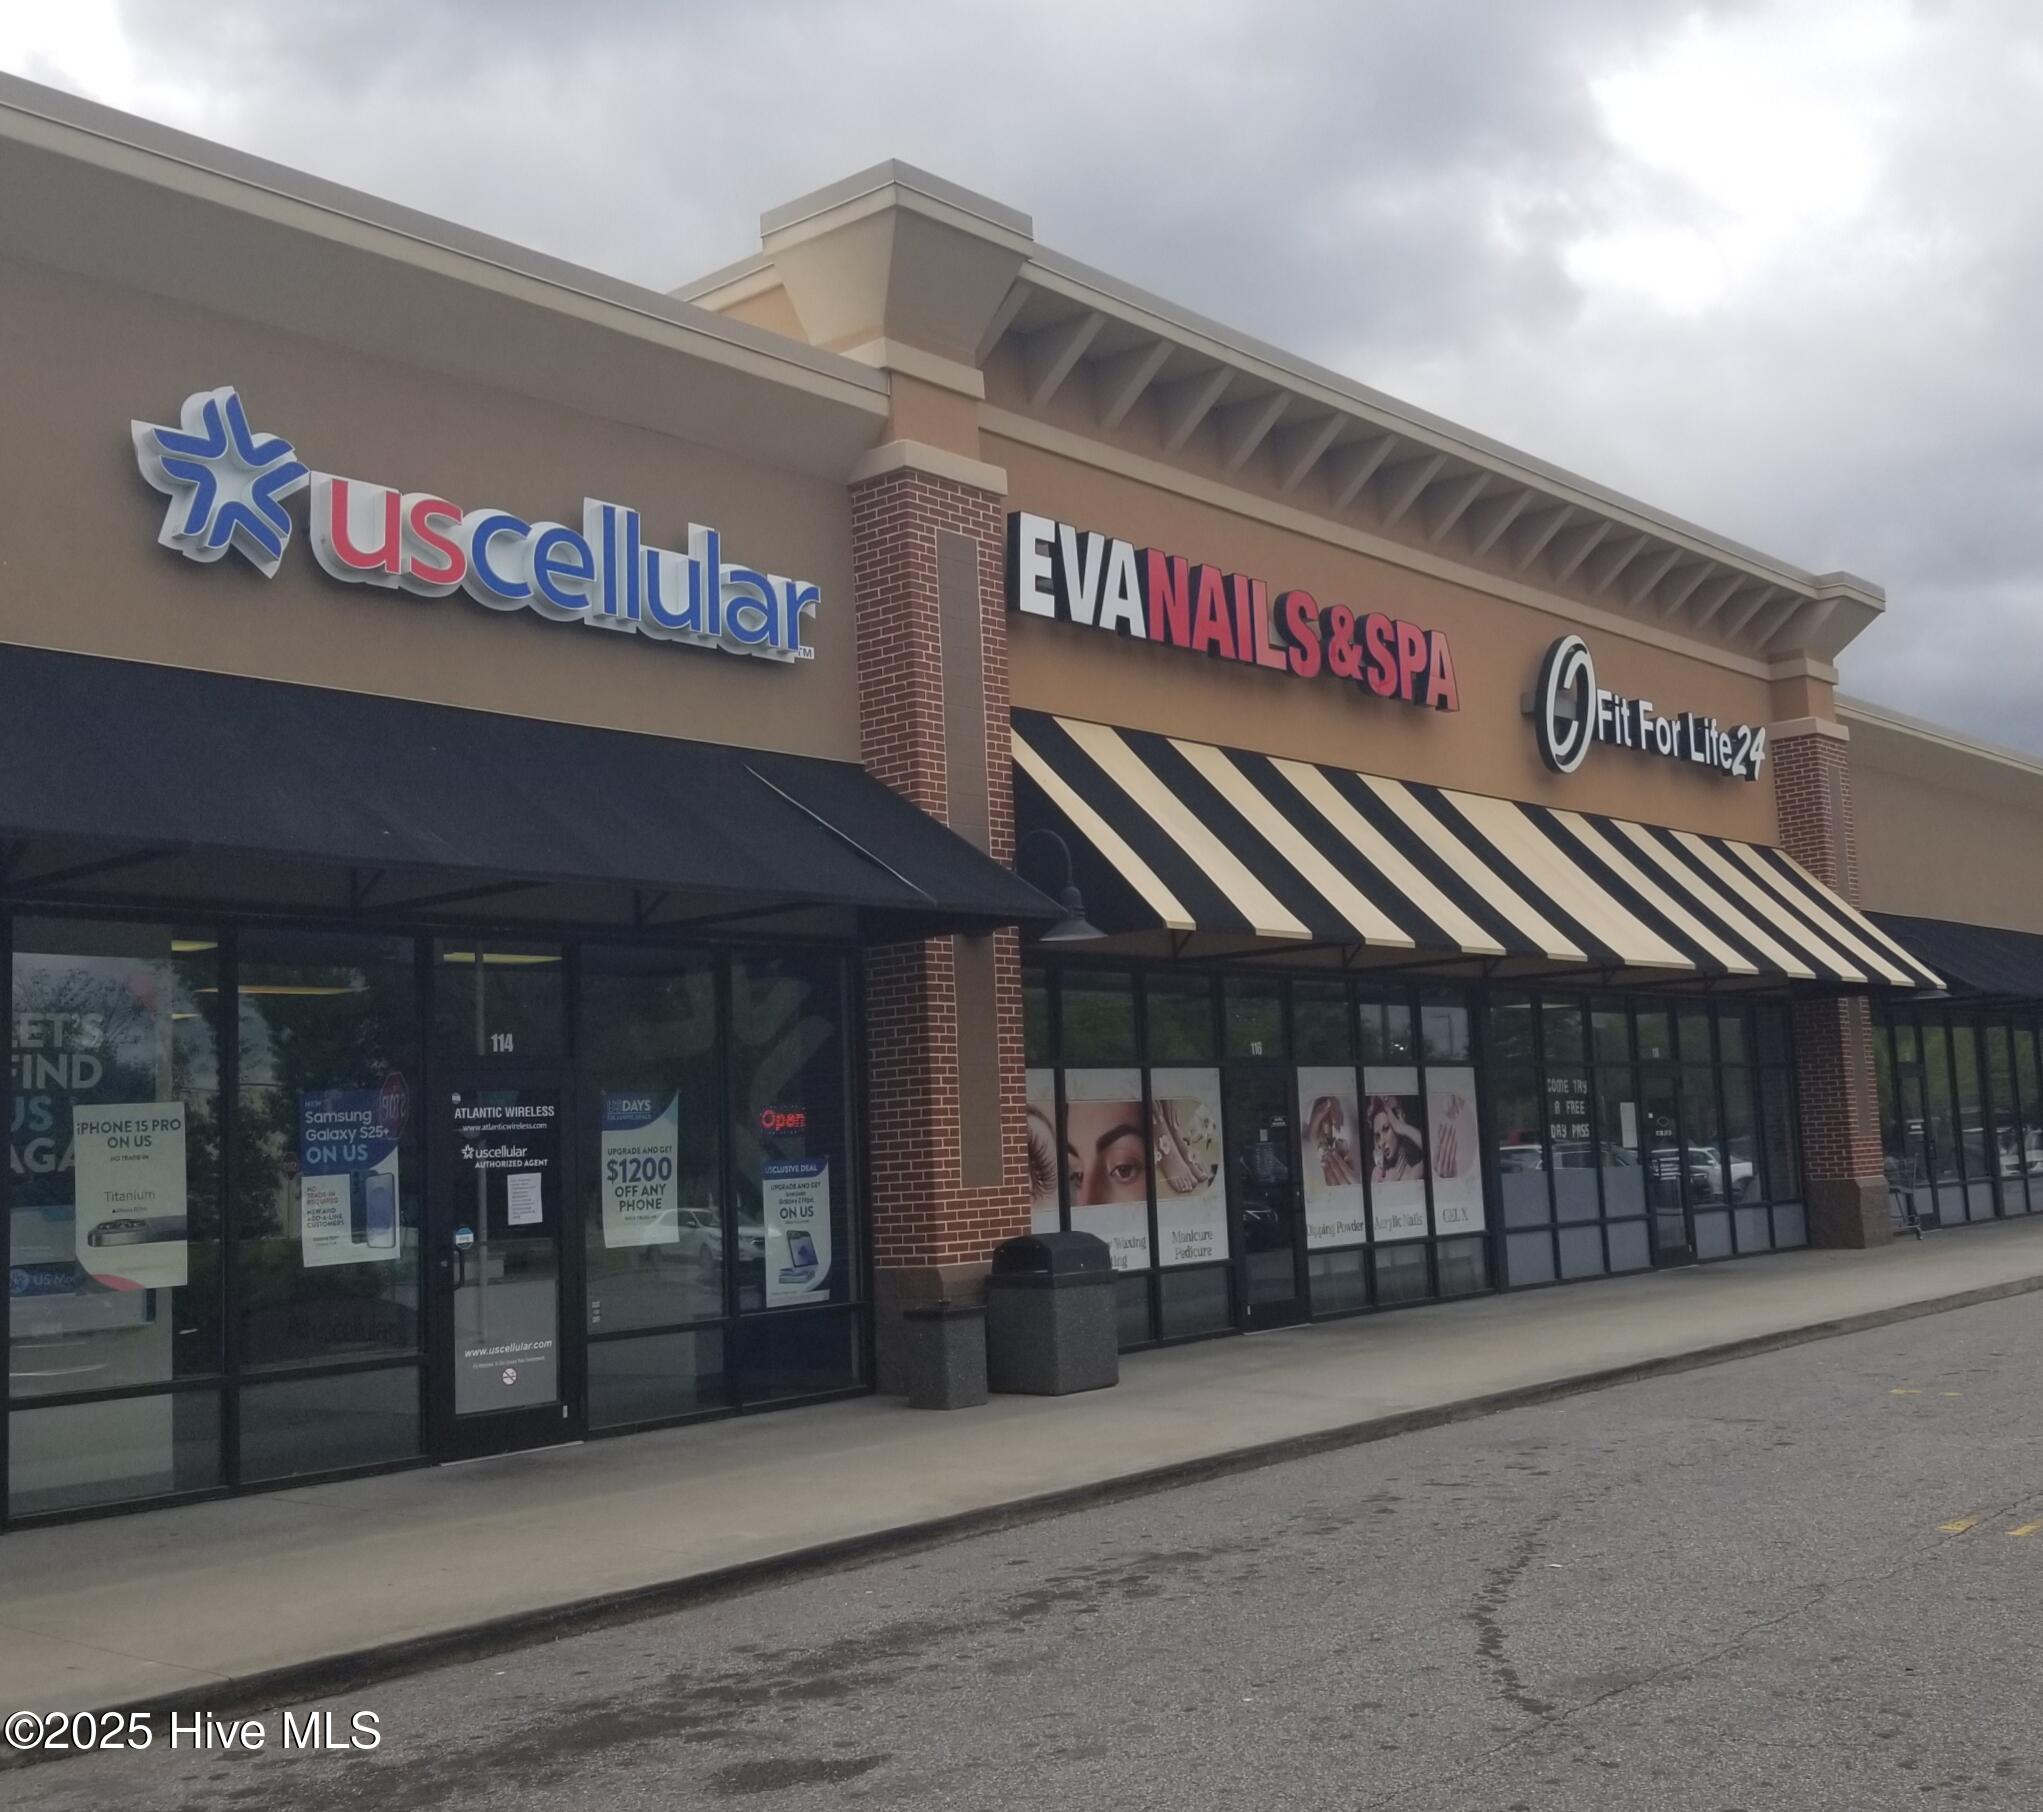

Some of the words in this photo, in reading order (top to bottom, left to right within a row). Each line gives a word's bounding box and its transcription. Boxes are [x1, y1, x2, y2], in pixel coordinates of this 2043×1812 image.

[324, 475, 822, 657] uscellular
[1596, 688, 1632, 748] Fit
[1638, 699, 1681, 758] For
[490, 1033, 514, 1053] 114
[1547, 1078, 1569, 1093] COME
[454, 1107, 503, 1119] ATLANTIC
[504, 1105, 555, 1118] WIRELESS
[622, 1099, 651, 1112] DAYS
[1554, 1100, 1561, 1115] A
[1566, 1100, 1586, 1115] FREE
[304, 1110, 373, 1125] Samsung
[760, 1108, 807, 1132] Open
[77, 1120, 132, 1135] iPHONE
[135, 1119, 149, 1132] 15
[151, 1118, 182, 1132] PRO
[462, 1122, 548, 1132] www.atlanticwireless.com
[1550, 1123, 1567, 1139] DAY
[1571, 1123, 1590, 1138] PASS
[107, 1136, 129, 1149] ON
[134, 1135, 153, 1148] US
[305, 1127, 357, 1144] Galaxy
[359, 1125, 390, 1139] S25+
[305, 1146, 338, 1164] ON
[343, 1145, 369, 1162] US
[475, 1144, 528, 1158] uscellular
[607, 1147, 641, 1156] UPGRADE
[642, 1146, 658, 1155] AND
[660, 1145, 673, 1154] GET
[474, 1159, 523, 1168] AUTHORIZED
[524, 1158, 548, 1167] AGENT
[607, 1156, 672, 1184] $1200
[104, 1190, 156, 1203] Titanium
[614, 1186, 638, 1198] OFF
[641, 1184, 667, 1197] ANY
[619, 1198, 662, 1212] PHONE
[779, 1207, 797, 1219] ON
[800, 1206, 814, 1218] US
[1336, 1218, 1364, 1234] Powder
[1113, 1236, 1147, 1250] Waxing
[1171, 1229, 1213, 1244] Manicure
[1175, 1245, 1212, 1260] Pedicure
[464, 1340, 553, 1358] www.uscellular.com
